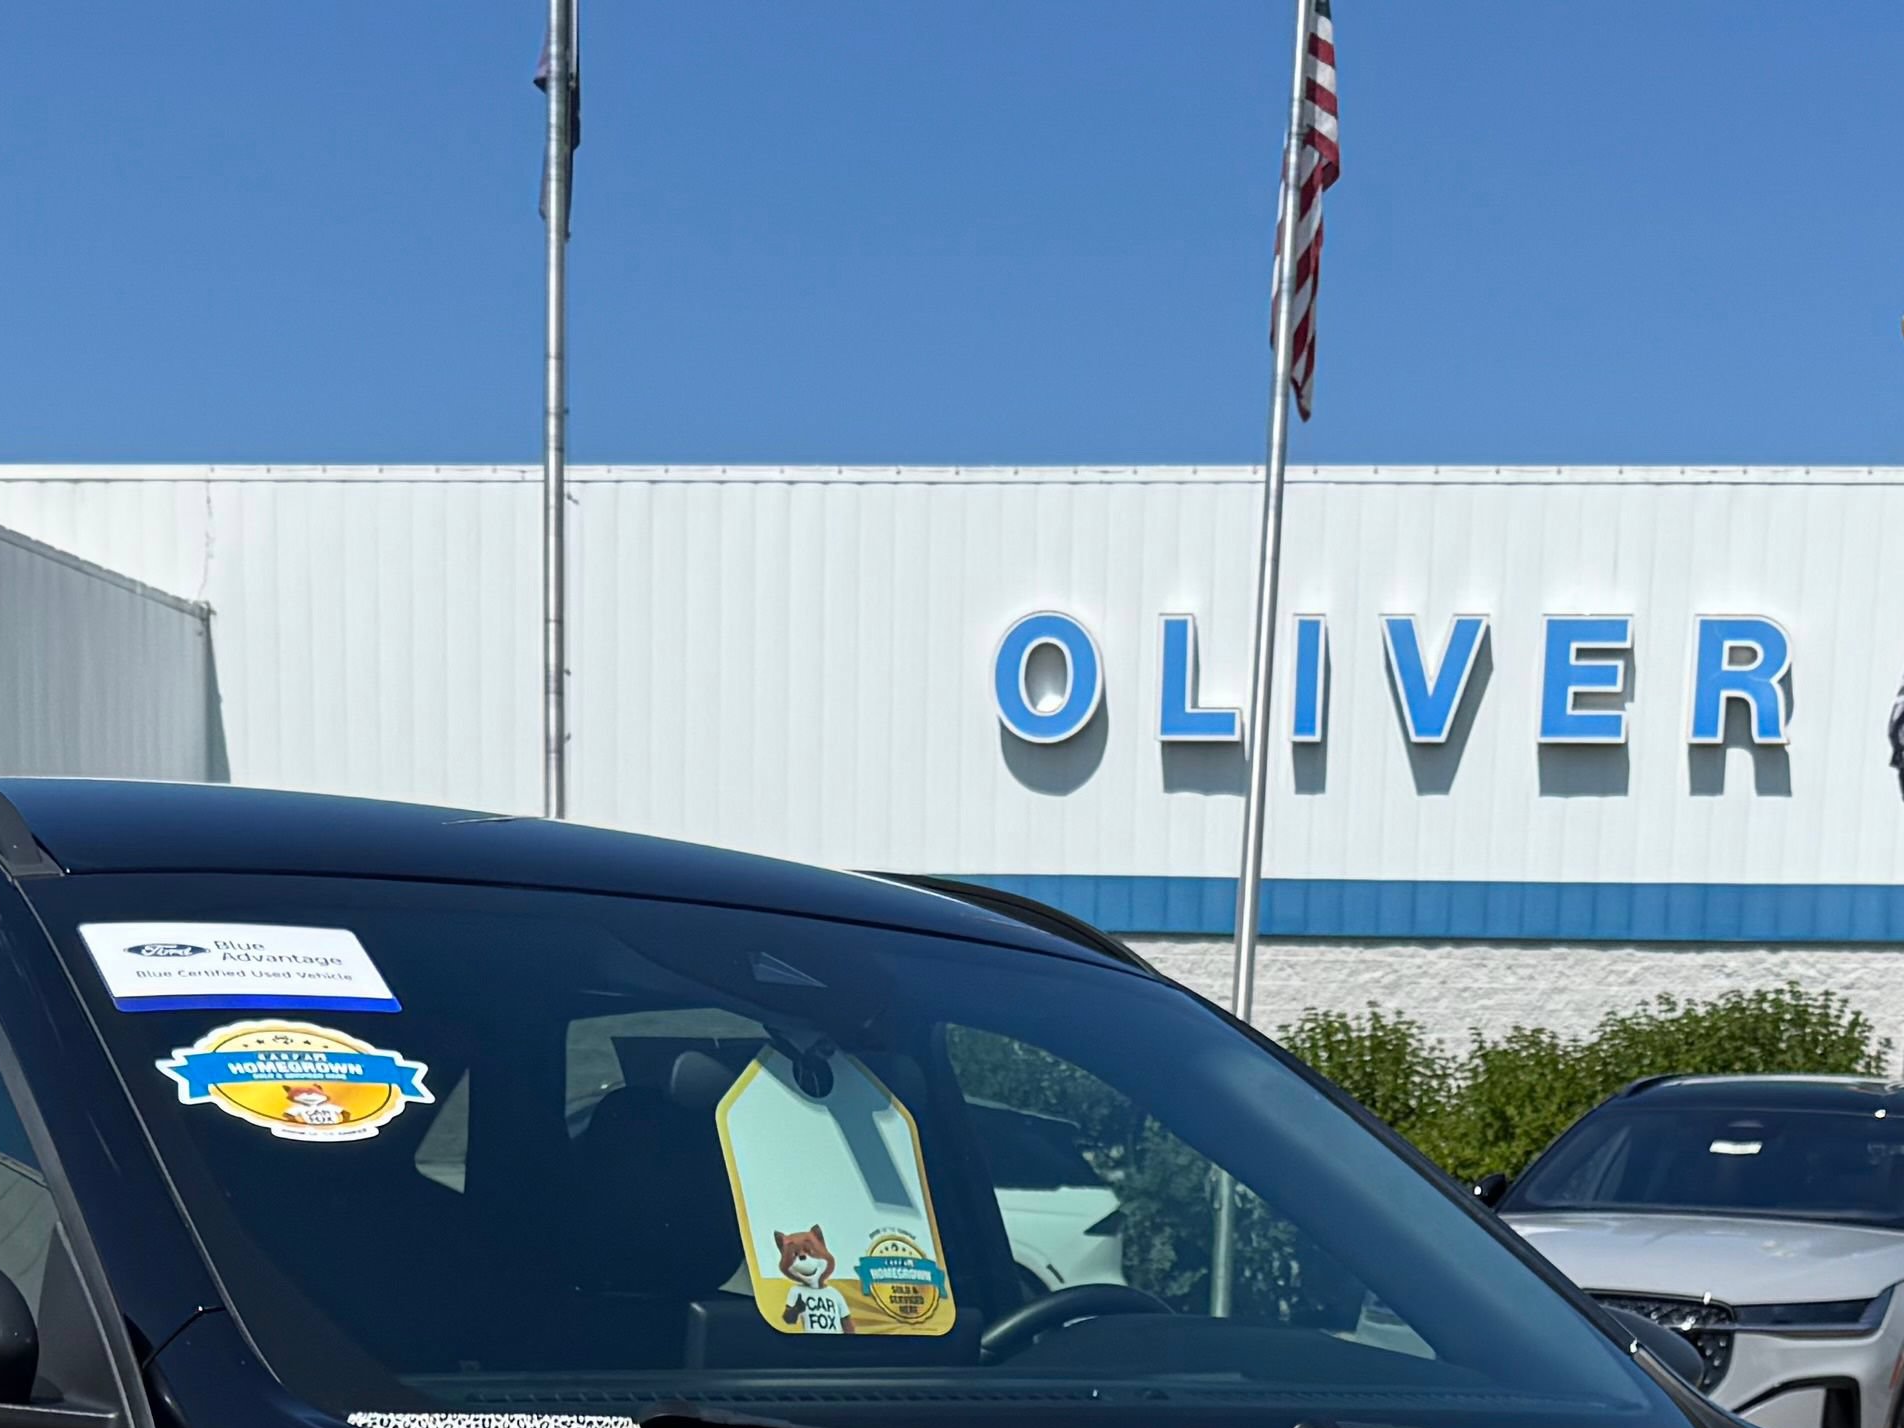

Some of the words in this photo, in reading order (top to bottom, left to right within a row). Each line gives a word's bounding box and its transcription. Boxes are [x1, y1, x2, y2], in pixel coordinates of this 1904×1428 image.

[993, 609, 1793, 746] OLIVER
[142, 943, 193, 957] Ford
[213, 940, 265, 951] Blue
[221, 951, 343, 967] Advantage
[135, 970, 173, 979] Blue
[177, 969, 246, 979] Certified
[251, 970, 292, 979] Used
[296, 971, 353, 982] Vehicle
[227, 1061, 364, 1076] HOMEGROWN
[806, 1296, 836, 1313] CAR
[808, 1313, 837, 1330] FOX
